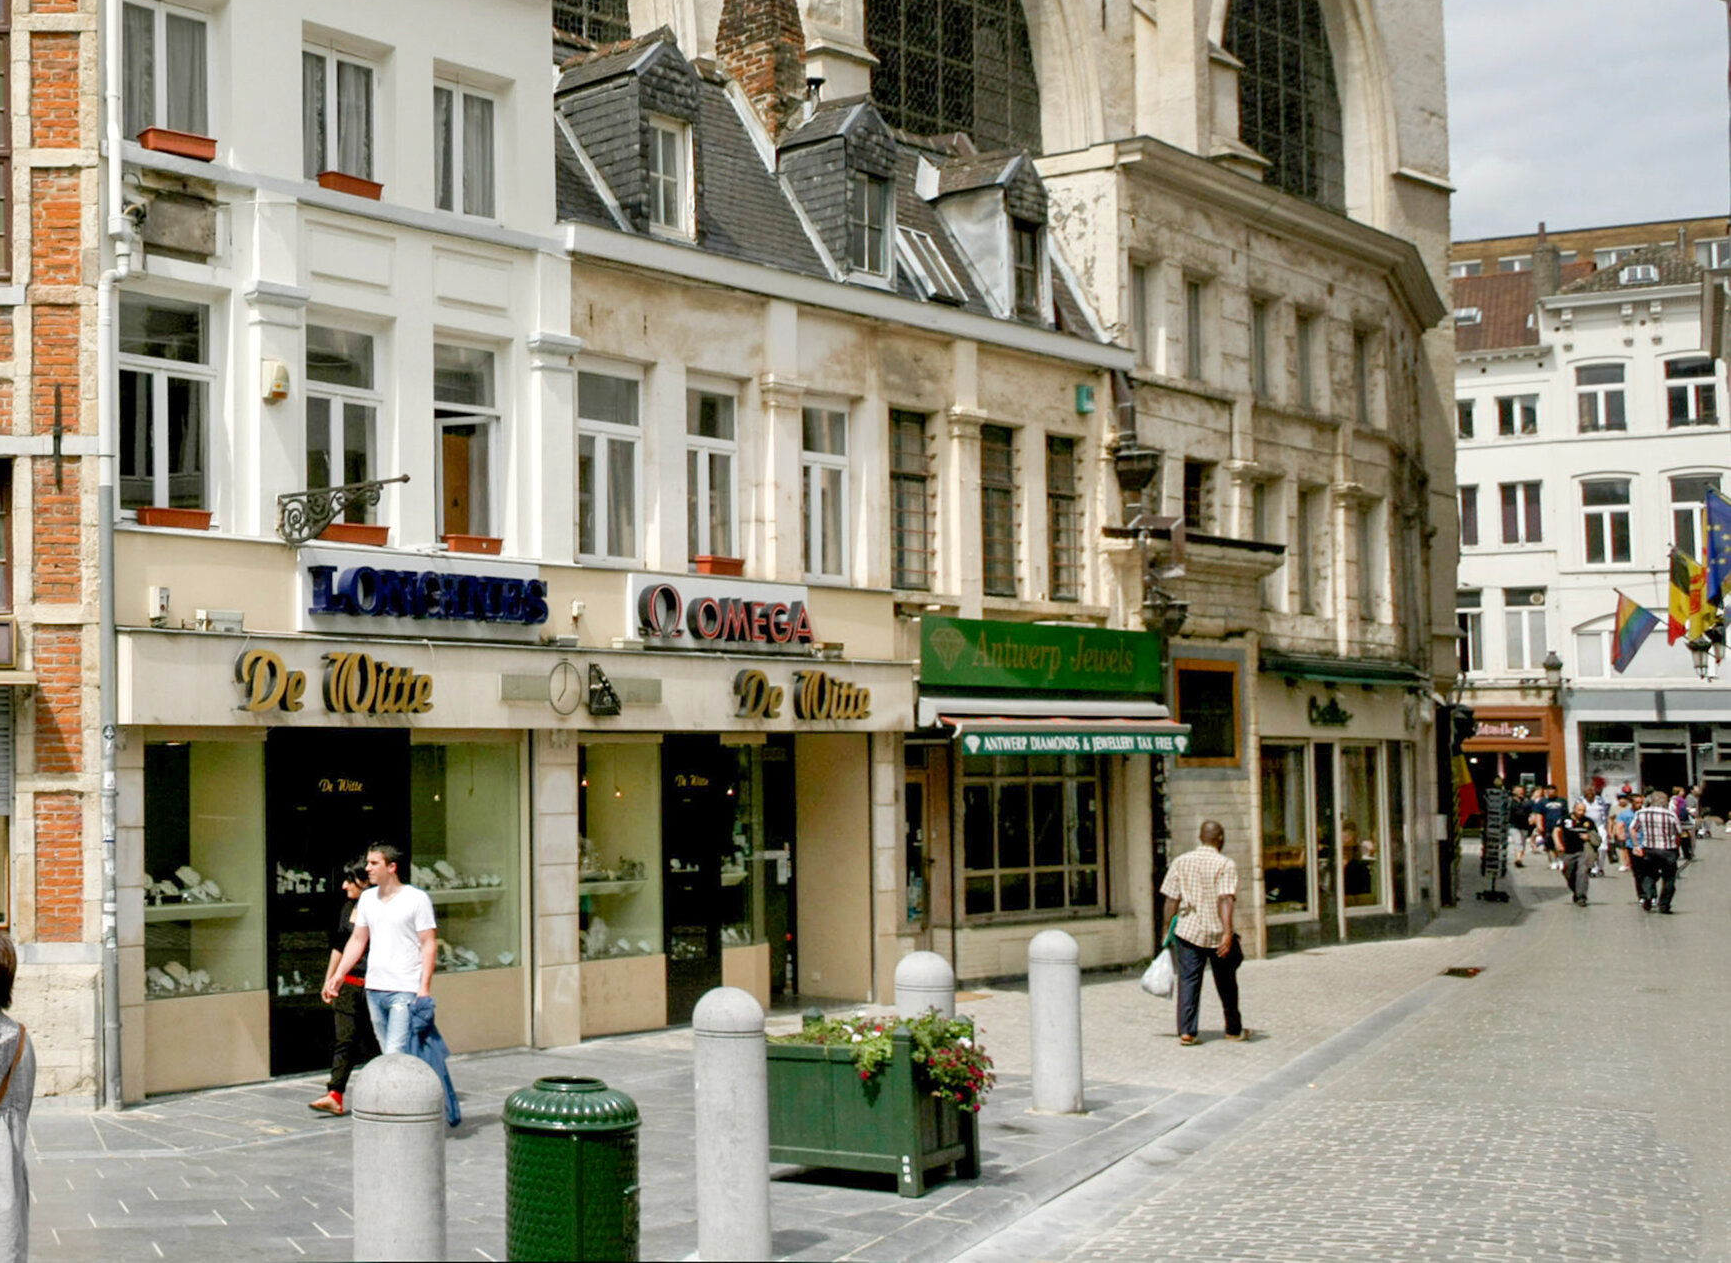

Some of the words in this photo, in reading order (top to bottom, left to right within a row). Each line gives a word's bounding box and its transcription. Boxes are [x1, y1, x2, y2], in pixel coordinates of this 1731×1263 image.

[307, 565, 549, 625] LONGINES
[687, 596, 815, 644] OMEGA
[971, 629, 1062, 680] Antwerp
[1070, 635, 1133, 674] Jewels
[235, 649, 307, 713] De
[321, 650, 434, 714] Witte
[734, 669, 784, 719] De
[792, 669, 872, 720] Witte
[983, 736, 1028, 751] ANTWERP
[1030, 736, 1080, 751] DIAMONDS
[1155, 736, 1173, 750] FREE
[318, 778, 334, 792] De
